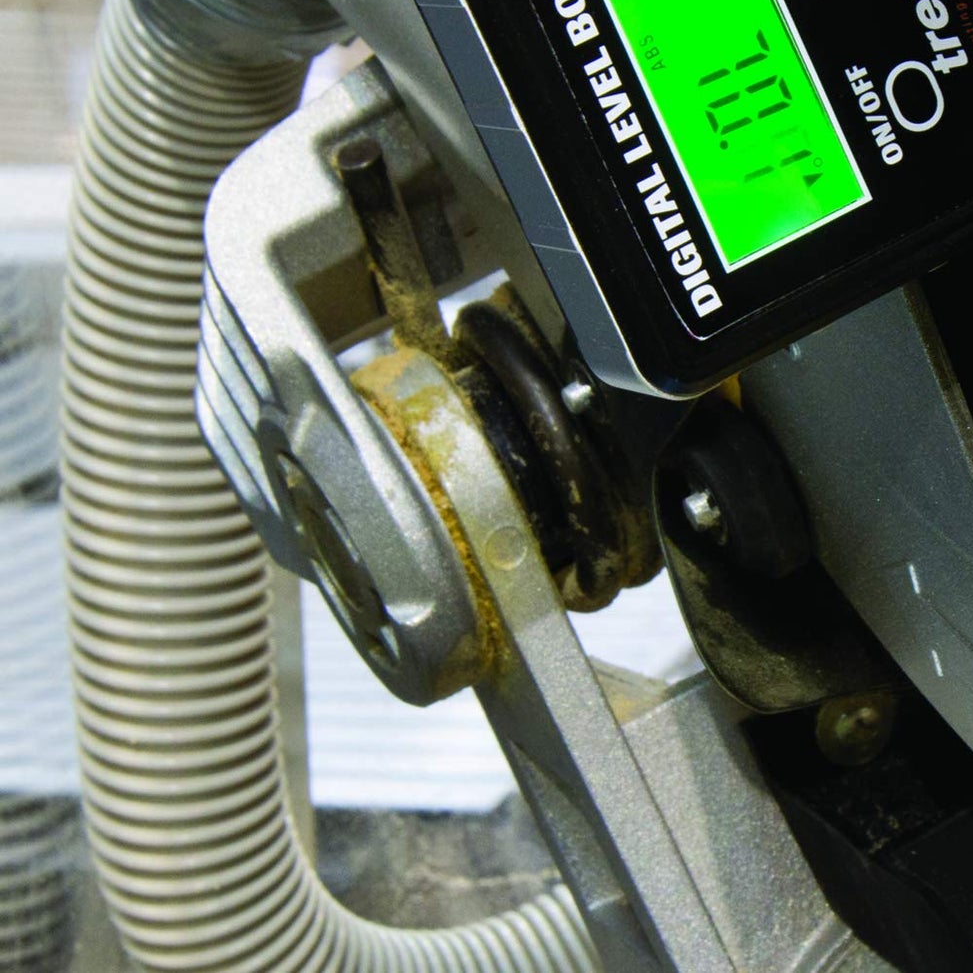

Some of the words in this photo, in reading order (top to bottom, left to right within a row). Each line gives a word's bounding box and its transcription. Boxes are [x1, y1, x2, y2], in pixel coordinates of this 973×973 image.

[585, 44, 653, 165] LEVEL
[640, 33, 666, 71] ABS
[844, 65, 903, 166] ON/OFF
[636, 162, 723, 318] DIGITAL
